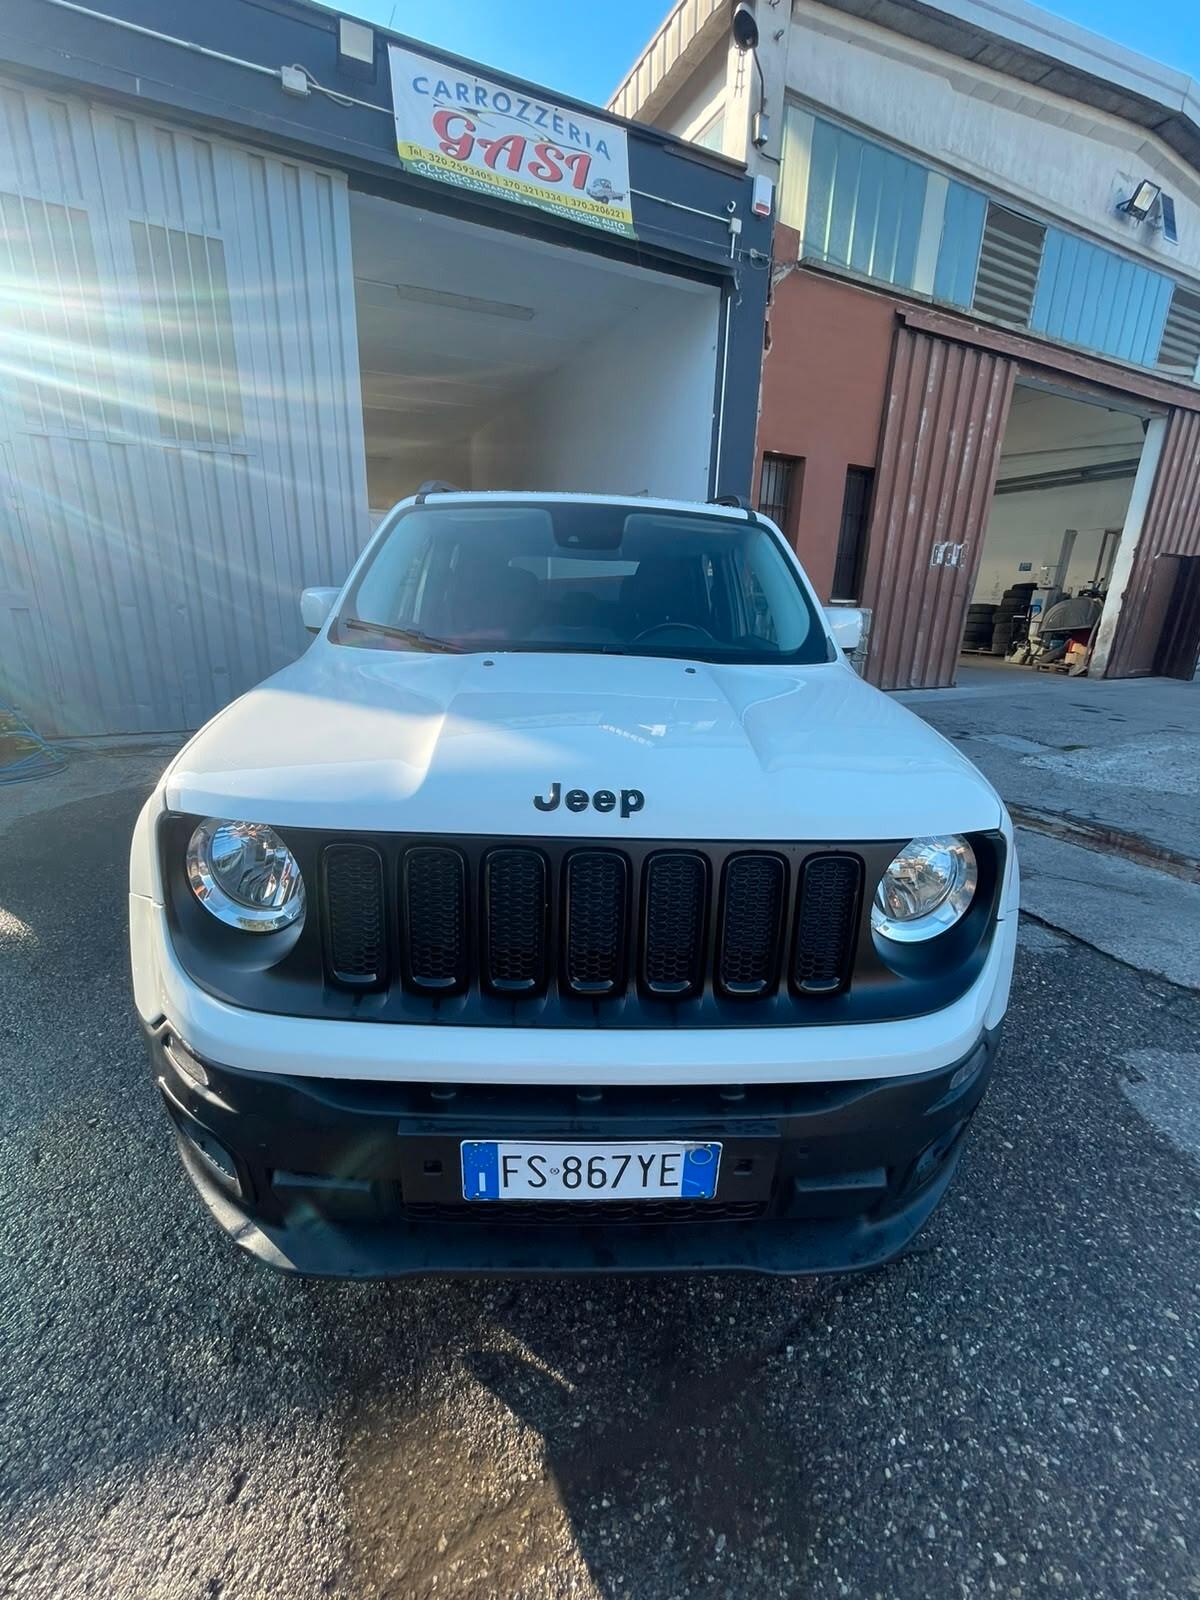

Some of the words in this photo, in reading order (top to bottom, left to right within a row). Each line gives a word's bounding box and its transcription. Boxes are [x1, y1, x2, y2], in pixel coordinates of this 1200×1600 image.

[412, 76, 611, 161] CARROZZERIA
[408, 145, 426, 159] Tel.
[432, 110, 592, 191] GASI
[602, 218, 626, 231] AUTO
[533, 782, 645, 818] Jeep
